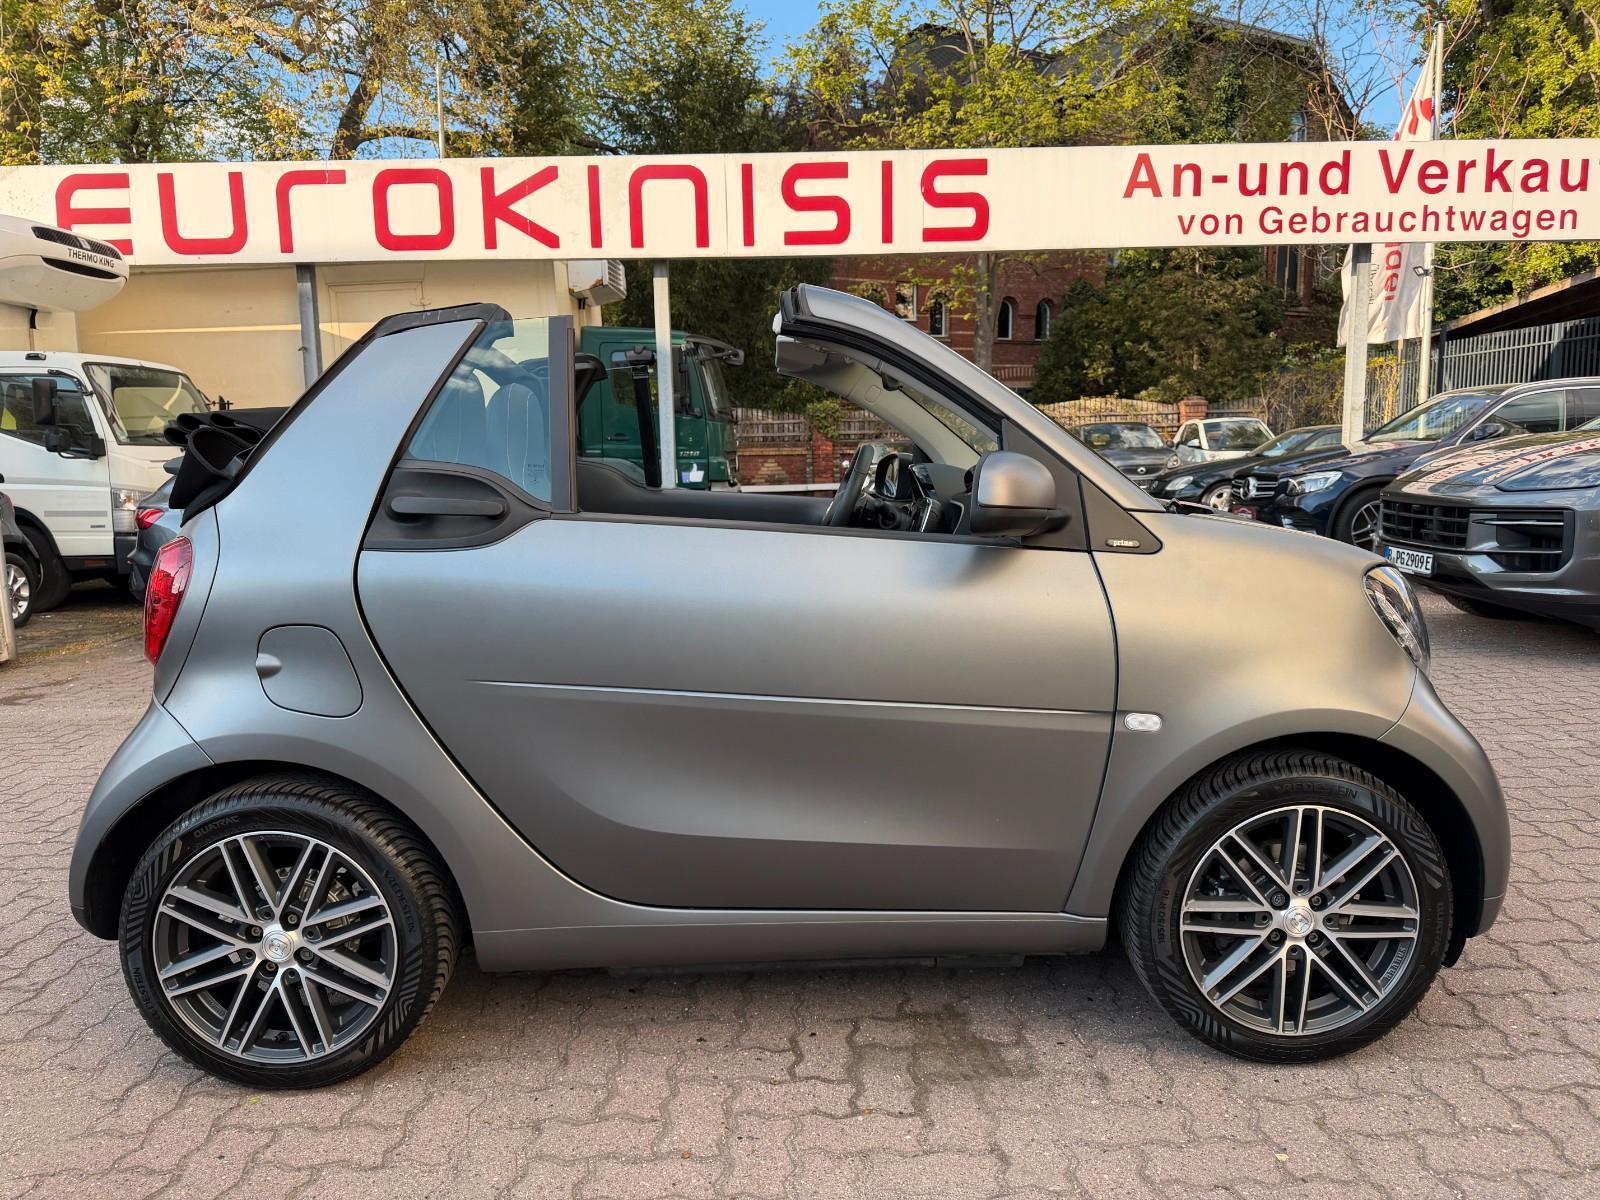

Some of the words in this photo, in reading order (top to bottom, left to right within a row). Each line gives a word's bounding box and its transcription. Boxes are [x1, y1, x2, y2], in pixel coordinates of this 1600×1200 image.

[1378, 147, 1600, 194] Verkau
[1177, 213, 1243, 236] von
[1258, 204, 1579, 239] Gebrauchtwagen
[67, 248, 98, 264] THERMO
[98, 255, 115, 269] KING
